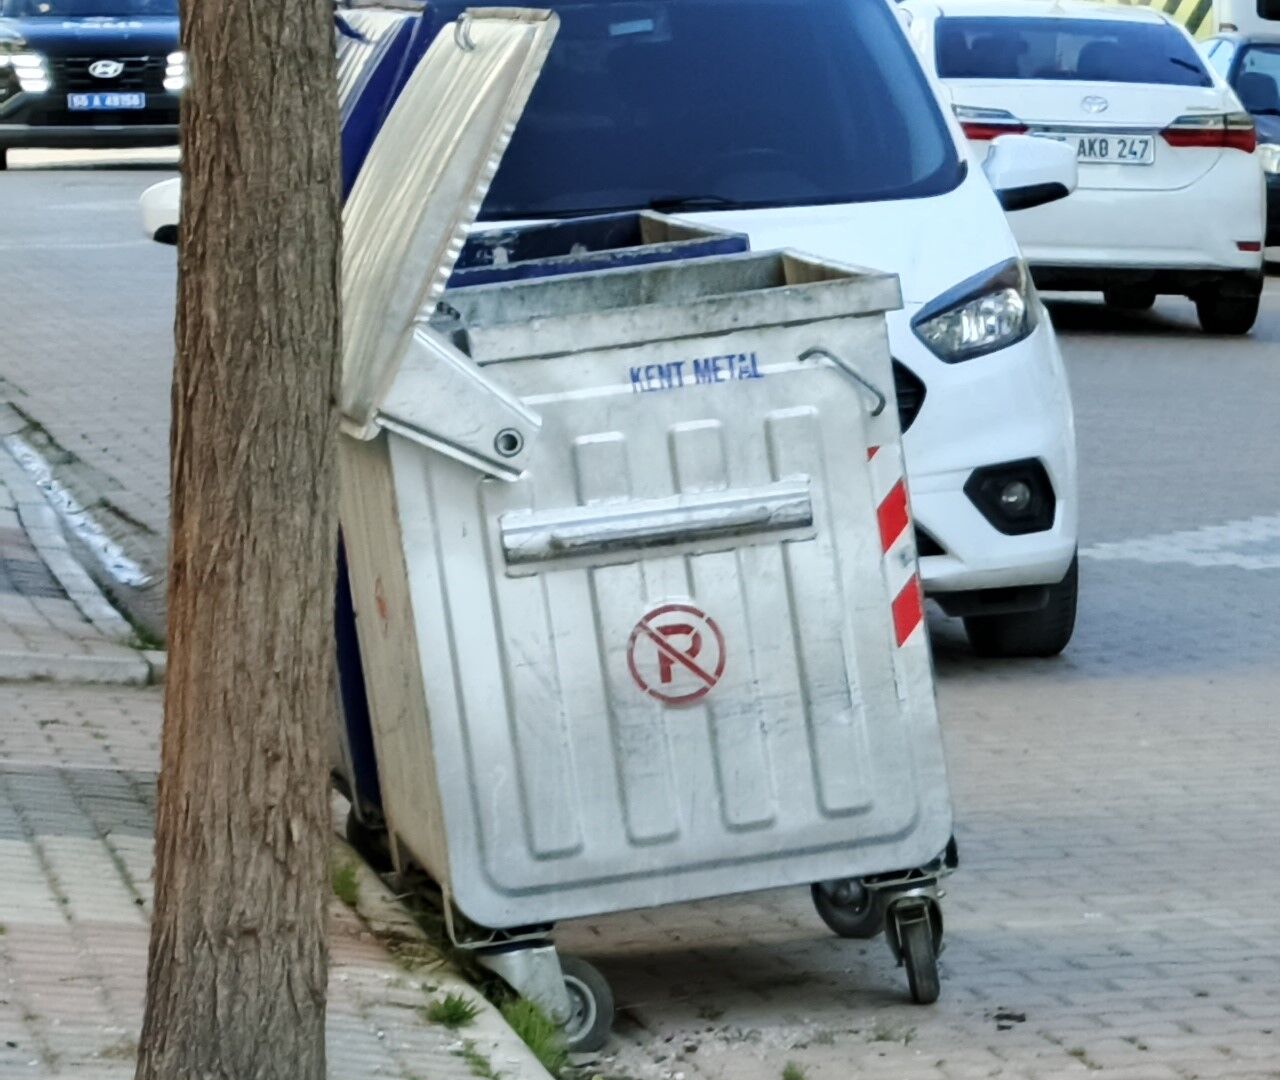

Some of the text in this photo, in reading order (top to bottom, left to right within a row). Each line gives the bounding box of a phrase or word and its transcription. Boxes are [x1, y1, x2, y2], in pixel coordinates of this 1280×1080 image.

[1117, 139, 1149, 159] 247
[629, 352, 764, 393] KENT METAL
